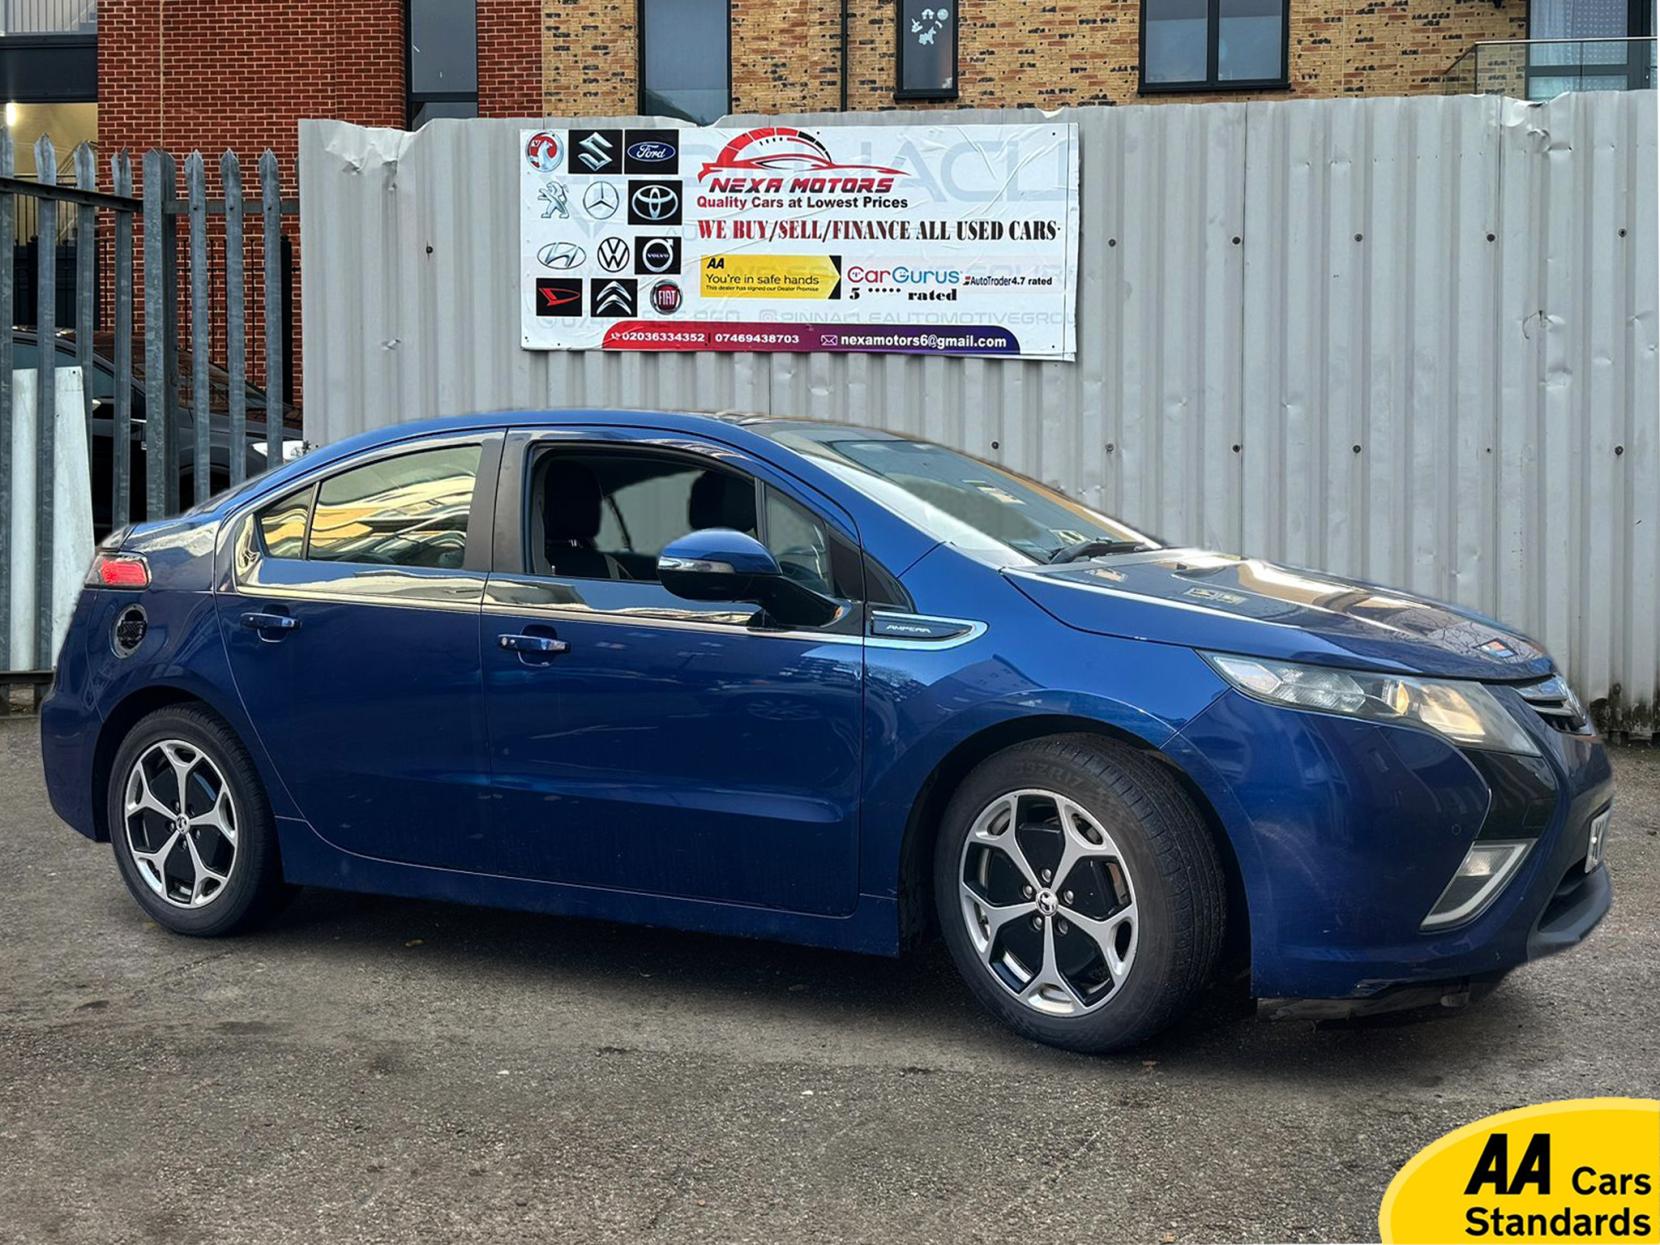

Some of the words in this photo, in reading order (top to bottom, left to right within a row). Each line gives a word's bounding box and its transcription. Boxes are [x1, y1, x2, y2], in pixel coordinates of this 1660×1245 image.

[637, 145, 665, 159] Ford
[709, 178, 783, 194] NEXA
[789, 178, 894, 194] MOTORS
[697, 196, 746, 210] Quality
[751, 196, 784, 208] Cars
[788, 196, 802, 208] at
[807, 196, 859, 208] Lowest
[863, 196, 908, 208] Prices
[697, 220, 726, 240] WE
[916, 221, 950, 240] ALL
[956, 221, 1003, 240] USED
[1008, 221, 1056, 240] CARS
[707, 257, 724, 269] AA
[706, 274, 740, 284] You're
[744, 274, 754, 283] in
[757, 274, 781, 284] safe
[784, 275, 819, 285] hands
[847, 266, 960, 284] CarGurus
[1028, 276, 1052, 286] rated
[658, 290, 676, 305] FIAT
[849, 288, 860, 300] 5
[908, 288, 957, 301] rated
[622, 332, 705, 342] 02036334352
[715, 333, 799, 343] 07469438703
[840, 335, 1007, 349] nexamotors6@gmail.com
[886, 624, 932, 633] AMPERA
